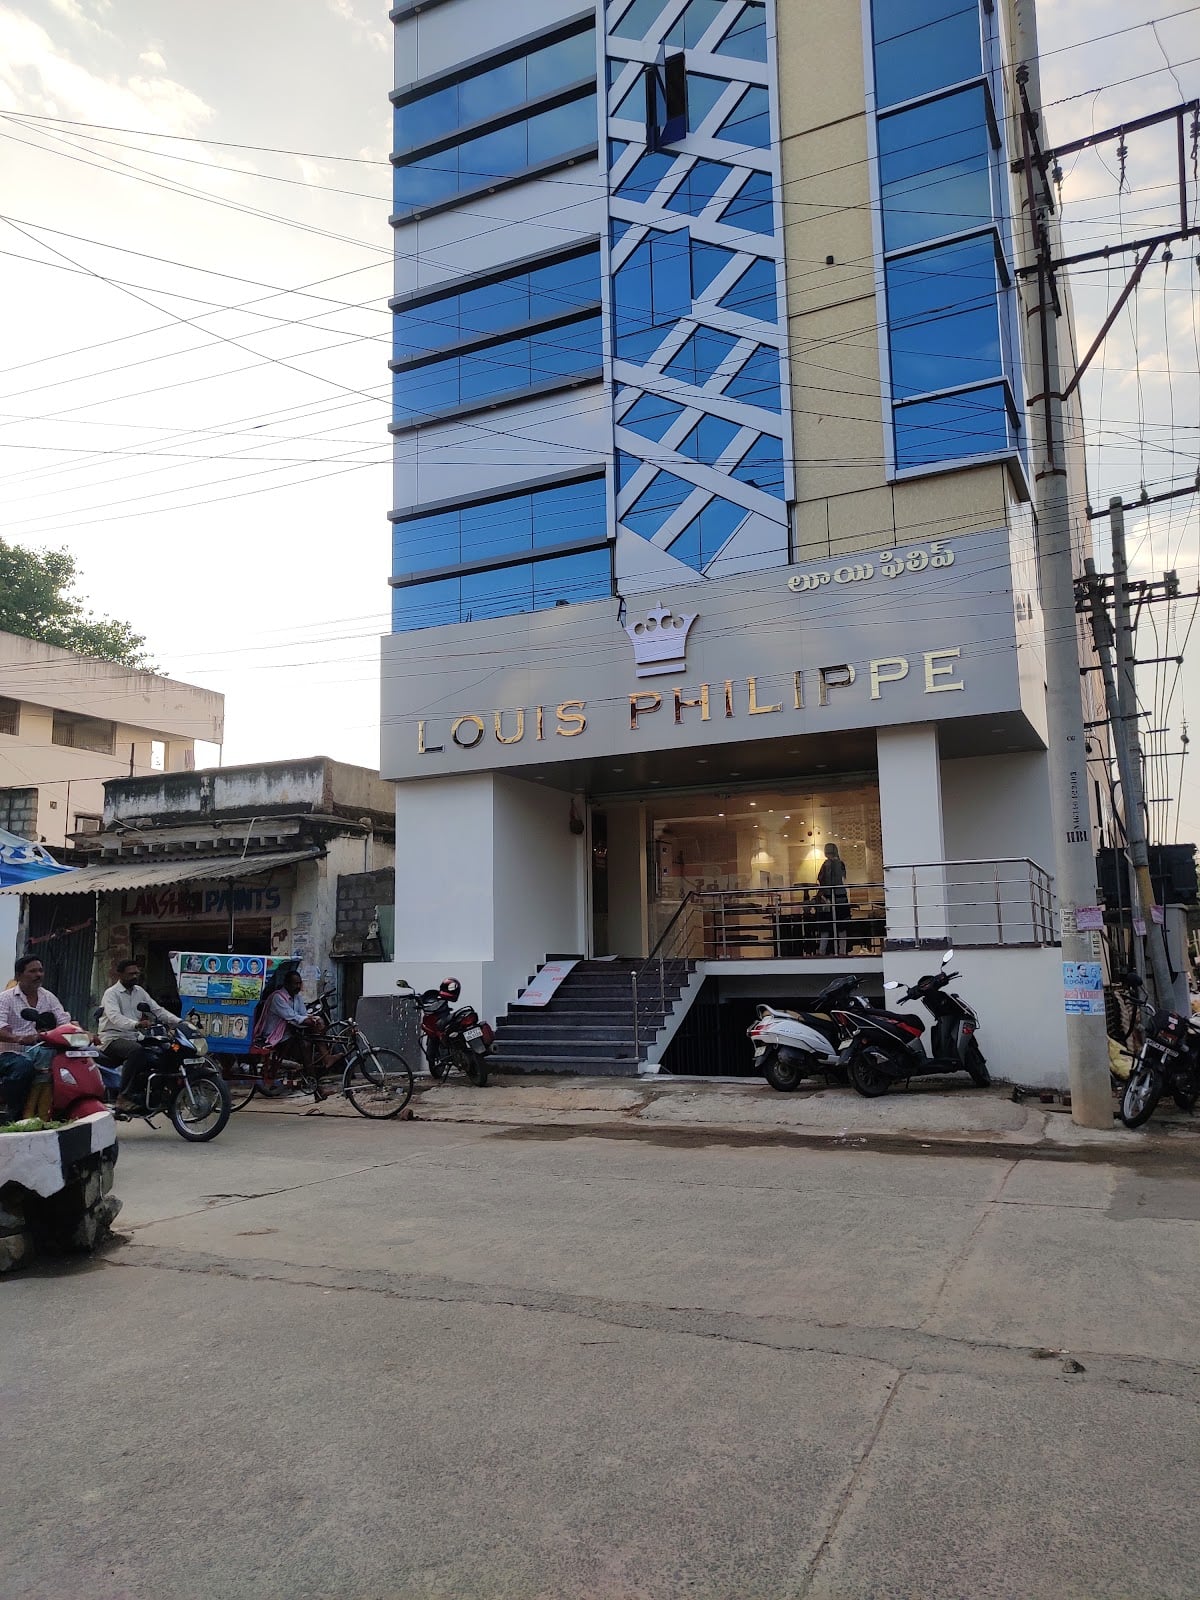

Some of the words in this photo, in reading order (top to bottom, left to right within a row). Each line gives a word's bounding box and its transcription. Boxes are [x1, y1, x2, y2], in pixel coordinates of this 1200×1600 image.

[787, 562, 875, 593] లూయి
[878, 539, 956, 579] ఫిలిప్
[416, 699, 590, 755] LOUIS
[628, 646, 966, 732] PHILIPPE
